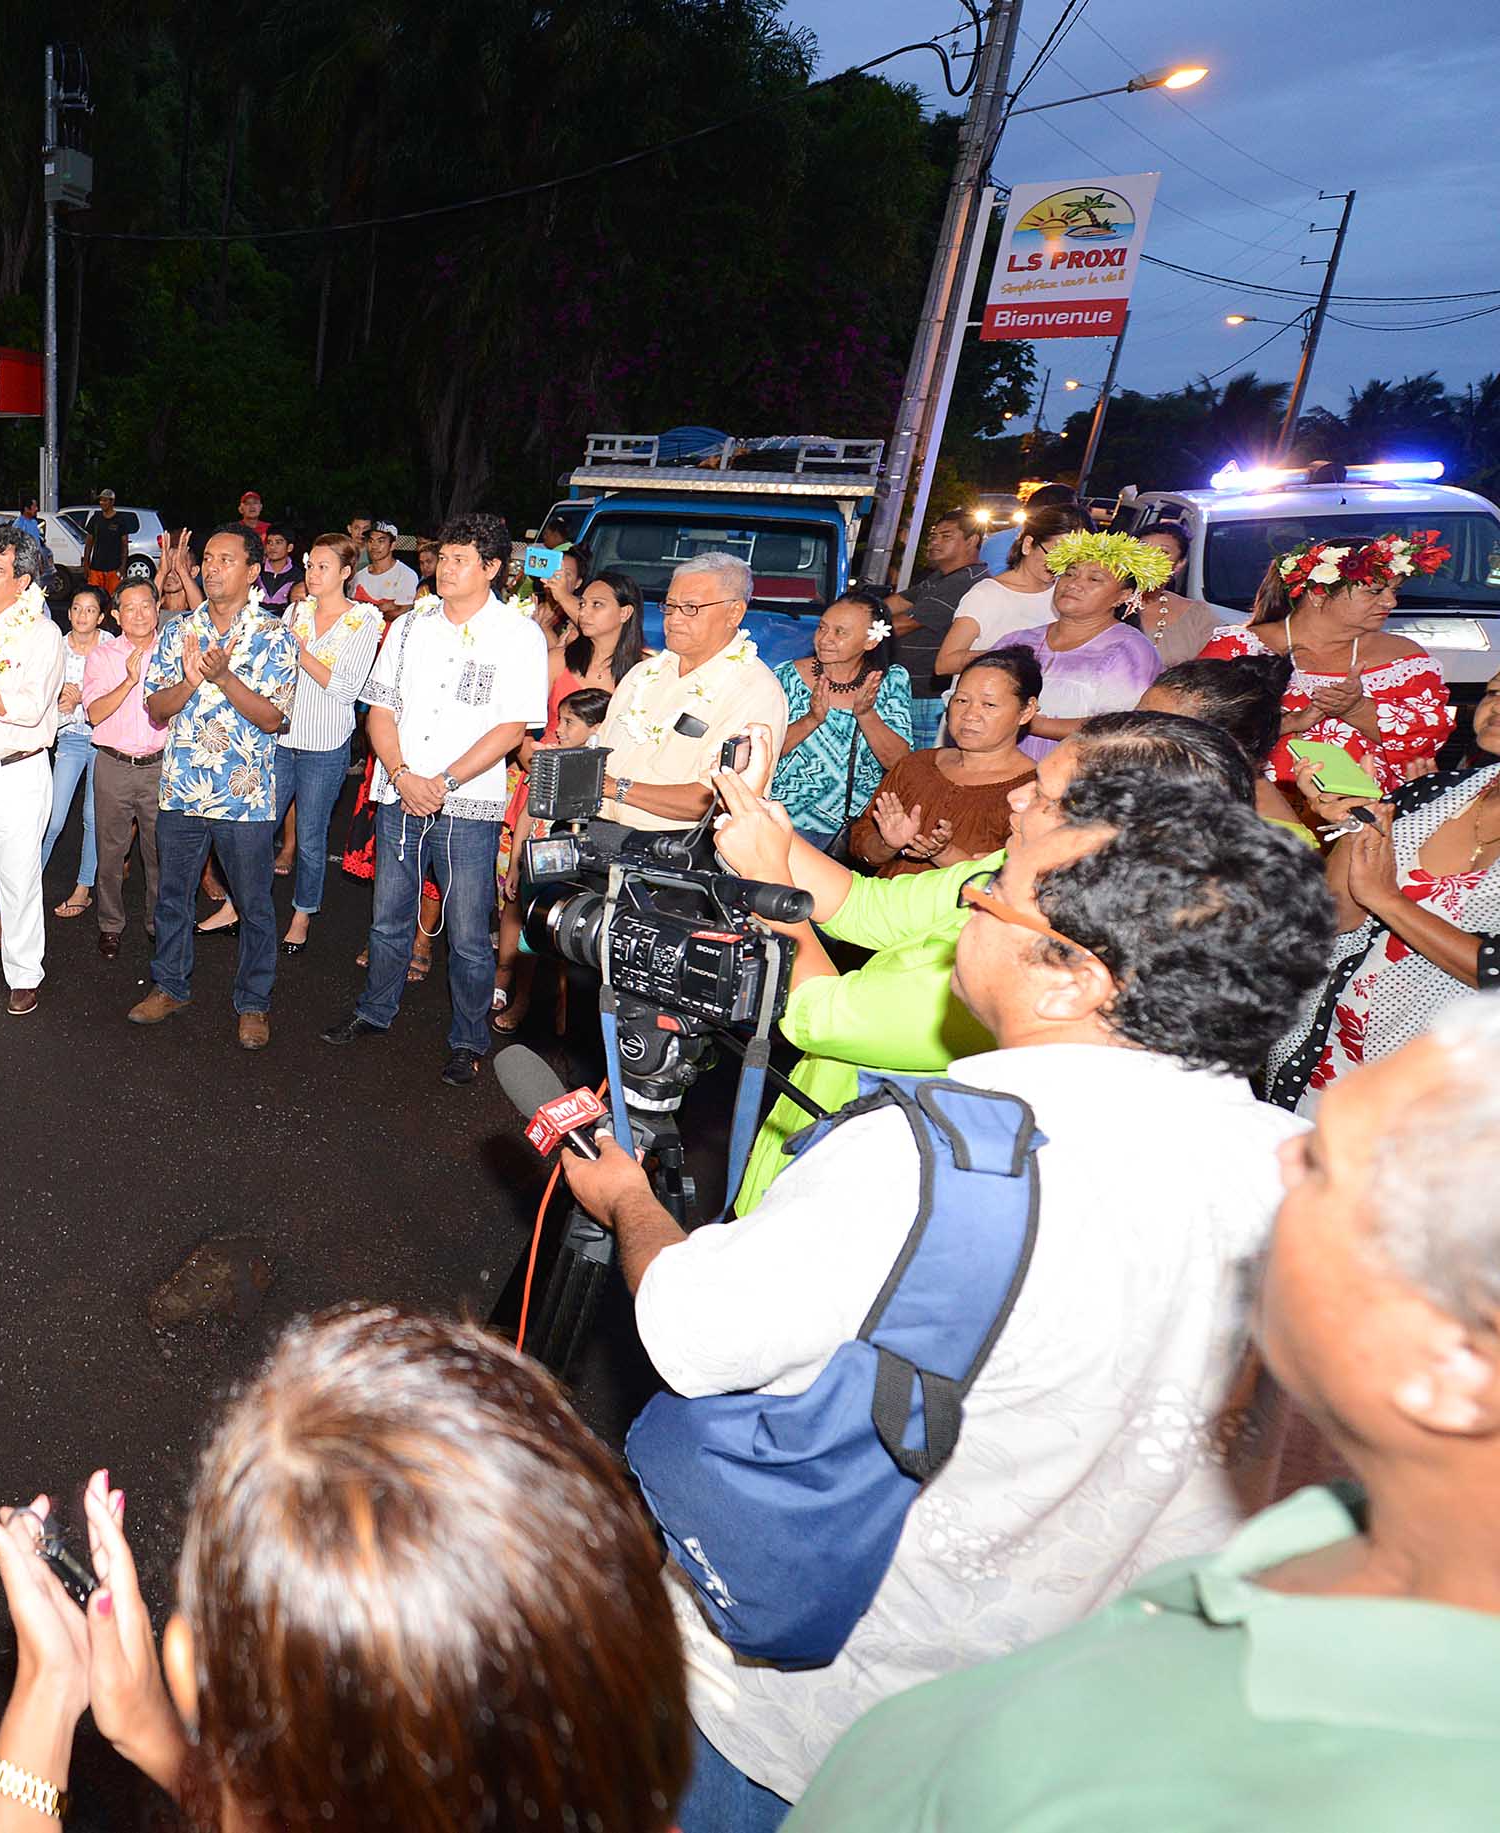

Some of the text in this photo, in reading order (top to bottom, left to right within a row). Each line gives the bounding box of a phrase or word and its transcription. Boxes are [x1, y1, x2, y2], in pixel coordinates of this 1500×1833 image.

[1050, 247, 1127, 270] PROXI
[994, 310, 1113, 327] Bienvenue
[696, 945, 722, 957] SONY
